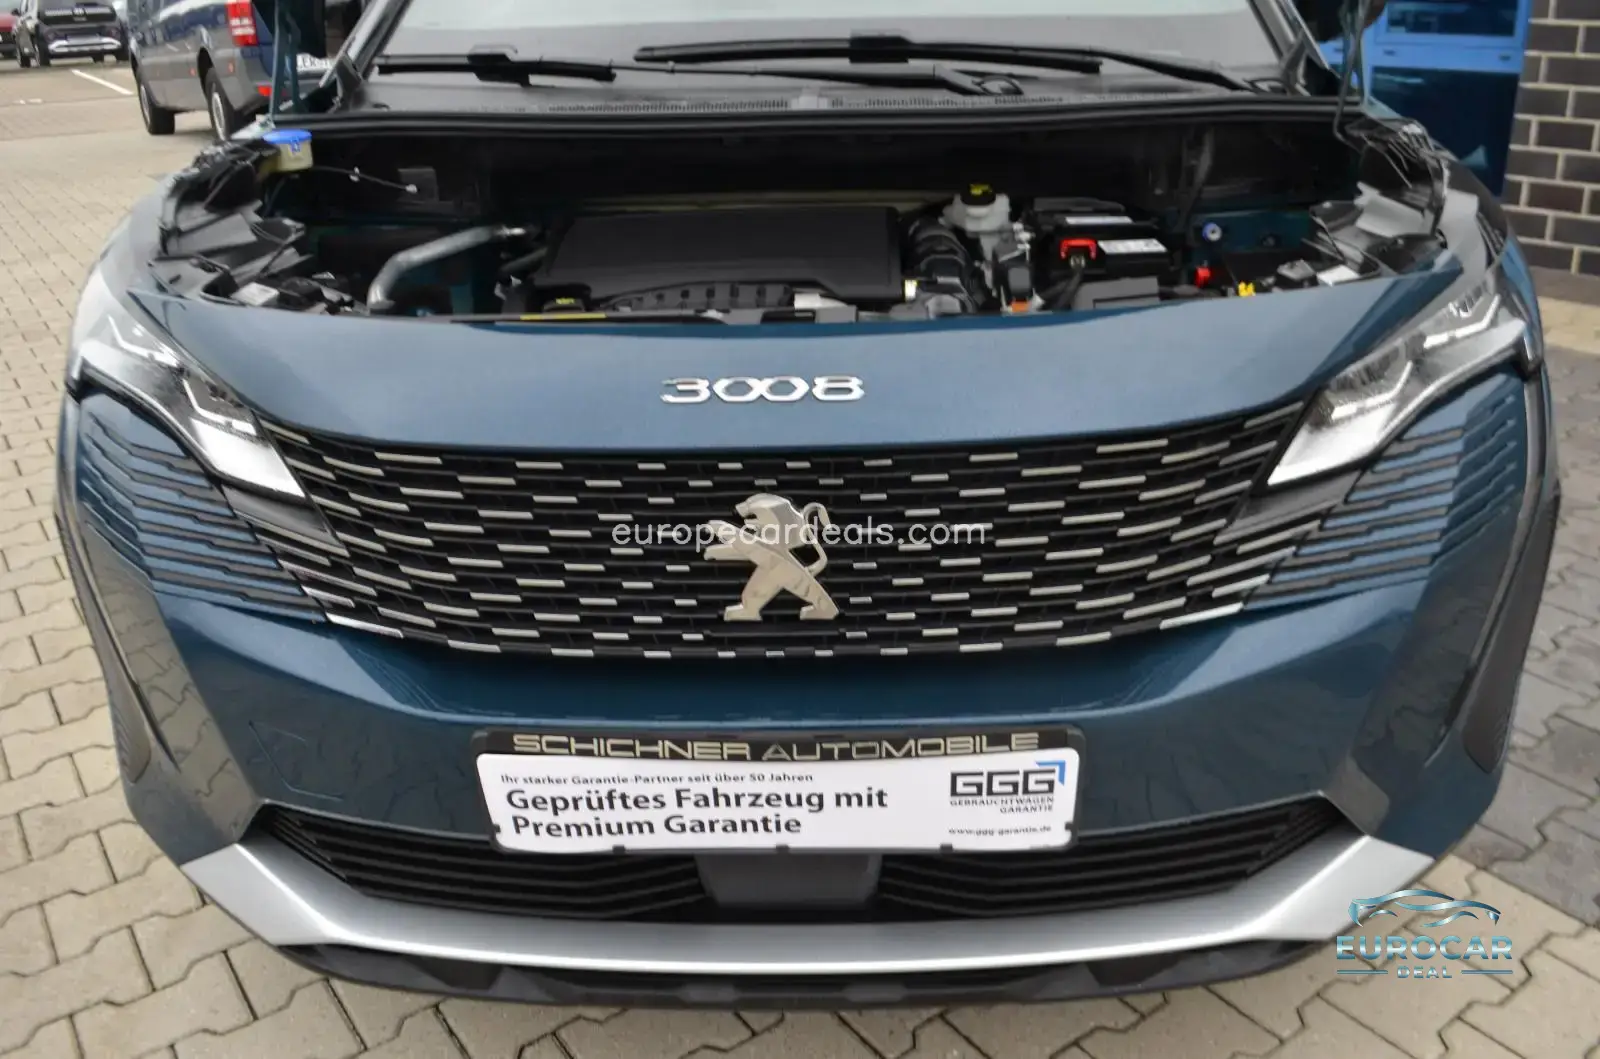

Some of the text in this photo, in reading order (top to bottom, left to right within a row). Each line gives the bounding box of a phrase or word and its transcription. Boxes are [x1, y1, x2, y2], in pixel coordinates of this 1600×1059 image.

[659, 375, 866, 404] 3008
[512, 732, 1040, 761] SCHICHNER AUTOMOBILE
[500, 774, 519, 785] Ihr
[523, 774, 568, 785] starker
[687, 774, 711, 784] seit
[714, 773, 747, 784] über
[749, 773, 766, 783] 50
[768, 773, 814, 783] Jahren
[949, 768, 1057, 798] GGG
[506, 786, 889, 816] Geprüftes Fahrzeug mit
[999, 805, 1054, 814] GARANTIE
[511, 814, 802, 839] Premium Garantie
